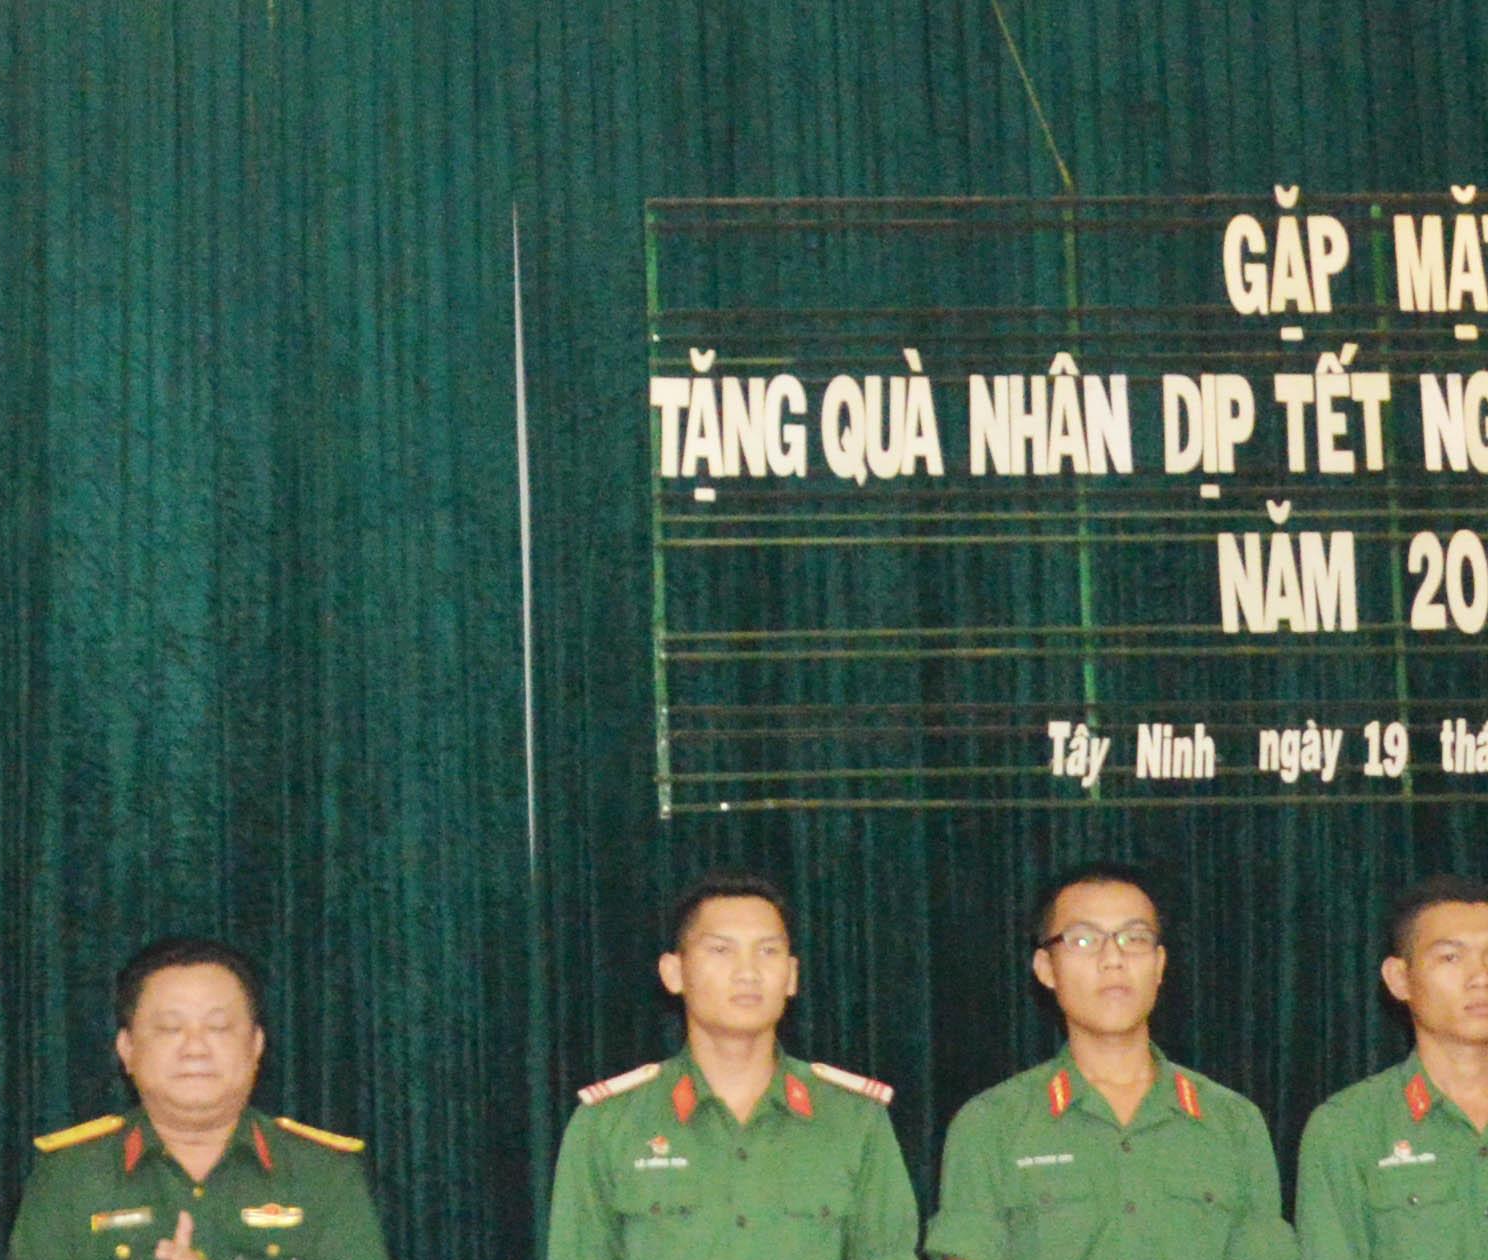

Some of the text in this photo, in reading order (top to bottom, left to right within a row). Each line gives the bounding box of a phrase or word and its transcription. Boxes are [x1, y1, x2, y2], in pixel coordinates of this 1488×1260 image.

[1222, 184, 1350, 342] GẶP
[649, 347, 808, 503] TẶNG
[820, 347, 945, 487] QUÀ
[968, 351, 1134, 476] NHÂN
[1161, 373, 1256, 499] DỊP
[1273, 342, 1391, 474] TẾT
[1217, 499, 1359, 634] NĂM
[1047, 720, 1111, 789] Tây
[1135, 722, 1217, 779] Ninh
[1258, 718, 1344, 784] ngày
[1363, 720, 1409, 778] 19
